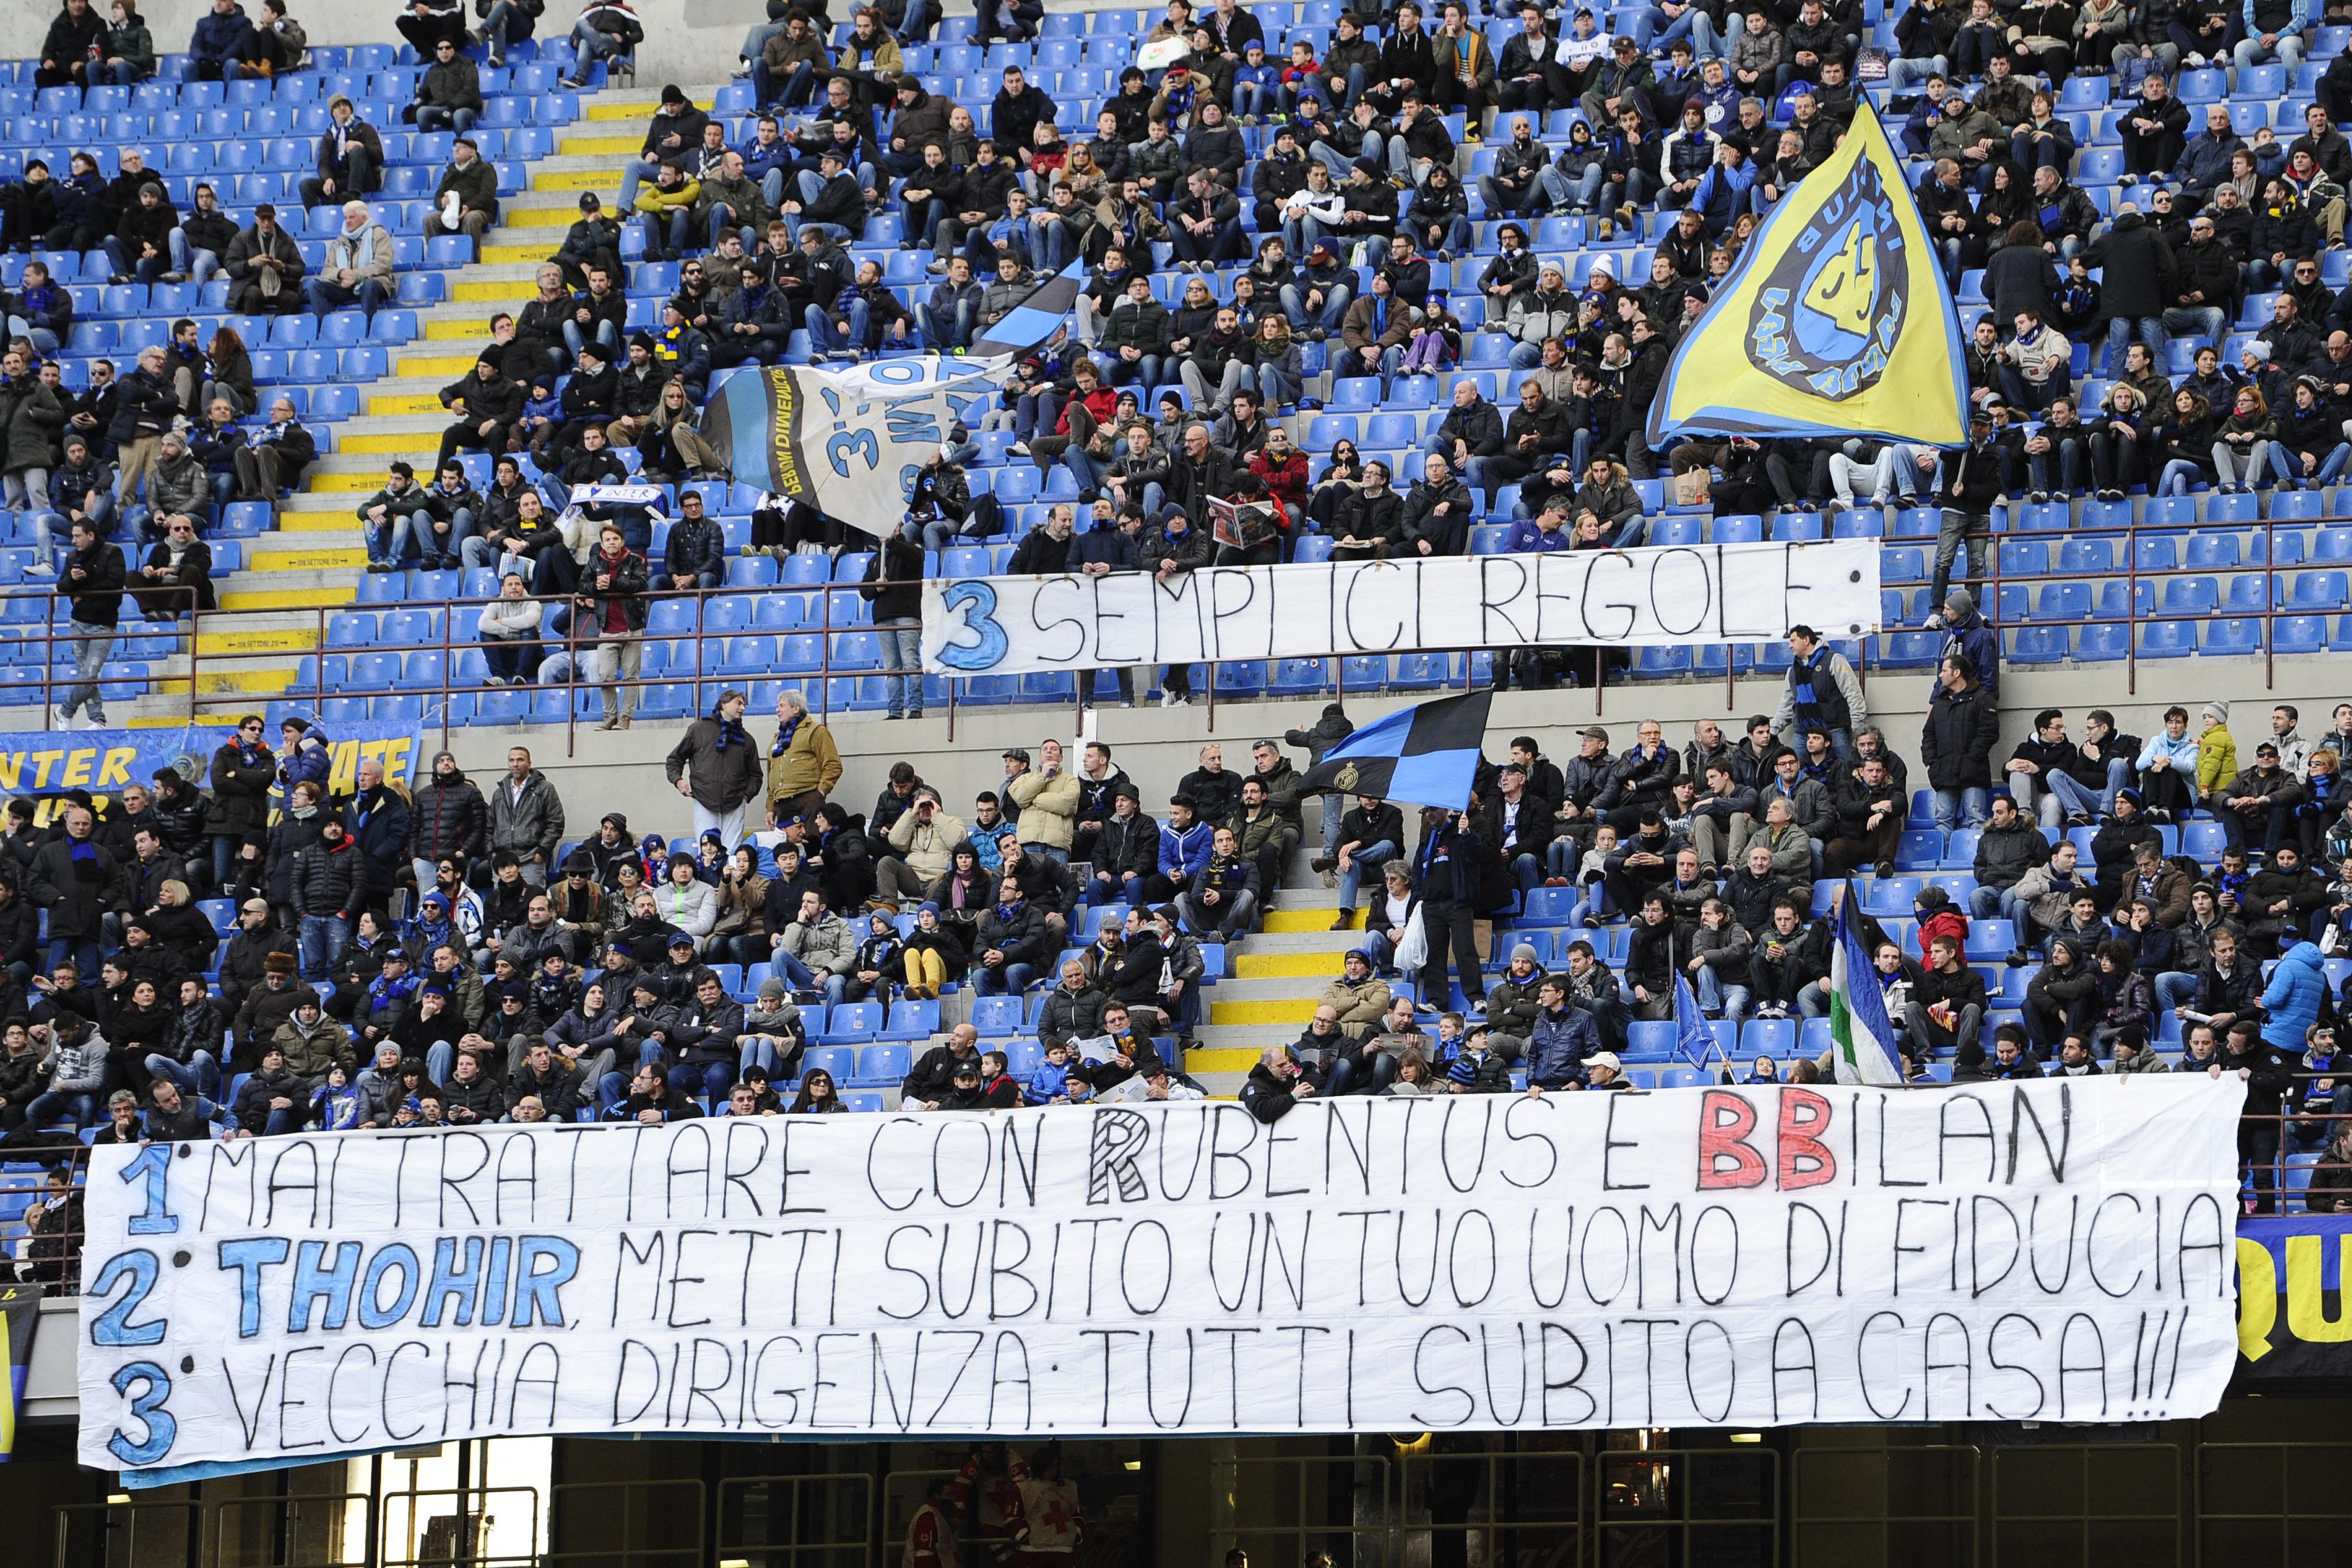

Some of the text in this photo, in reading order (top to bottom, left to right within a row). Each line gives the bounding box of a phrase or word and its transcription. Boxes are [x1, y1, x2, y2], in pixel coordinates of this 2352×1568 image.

[605, 489, 649, 499] INTER
[306, 558, 328, 566] SETTORE
[937, 582, 1012, 673] 3
[1032, 560, 1424, 666] SEMPLICI
[200, 1136, 345, 1231] MAI
[375, 1119, 827, 1226] TRATTARE
[866, 1114, 1045, 1210] CON
[1086, 1097, 1558, 1205] RUBENTUS
[1604, 1090, 1653, 1191] E
[1695, 1084, 2072, 1192] BBILAN
[612, 1230, 840, 1328] METTI
[878, 1220, 1171, 1321] SUBITO
[1210, 1211, 1311, 1311] UN
[1339, 1210, 1495, 1307] TUO
[1529, 1203, 1738, 1309] UOMO
[1787, 1201, 1847, 1298] DI
[1894, 1192, 2226, 1300] FIDUCIA
[222, 1339, 560, 1451] VECCHIA
[610, 1330, 1058, 1432] DIRIGENZA:
[1080, 1326, 1355, 1430] TUTTI
[1411, 1320, 1737, 1426] SUBITO
[1772, 1318, 1818, 1422] A
[1857, 1305, 2188, 1421] CASA!!!
